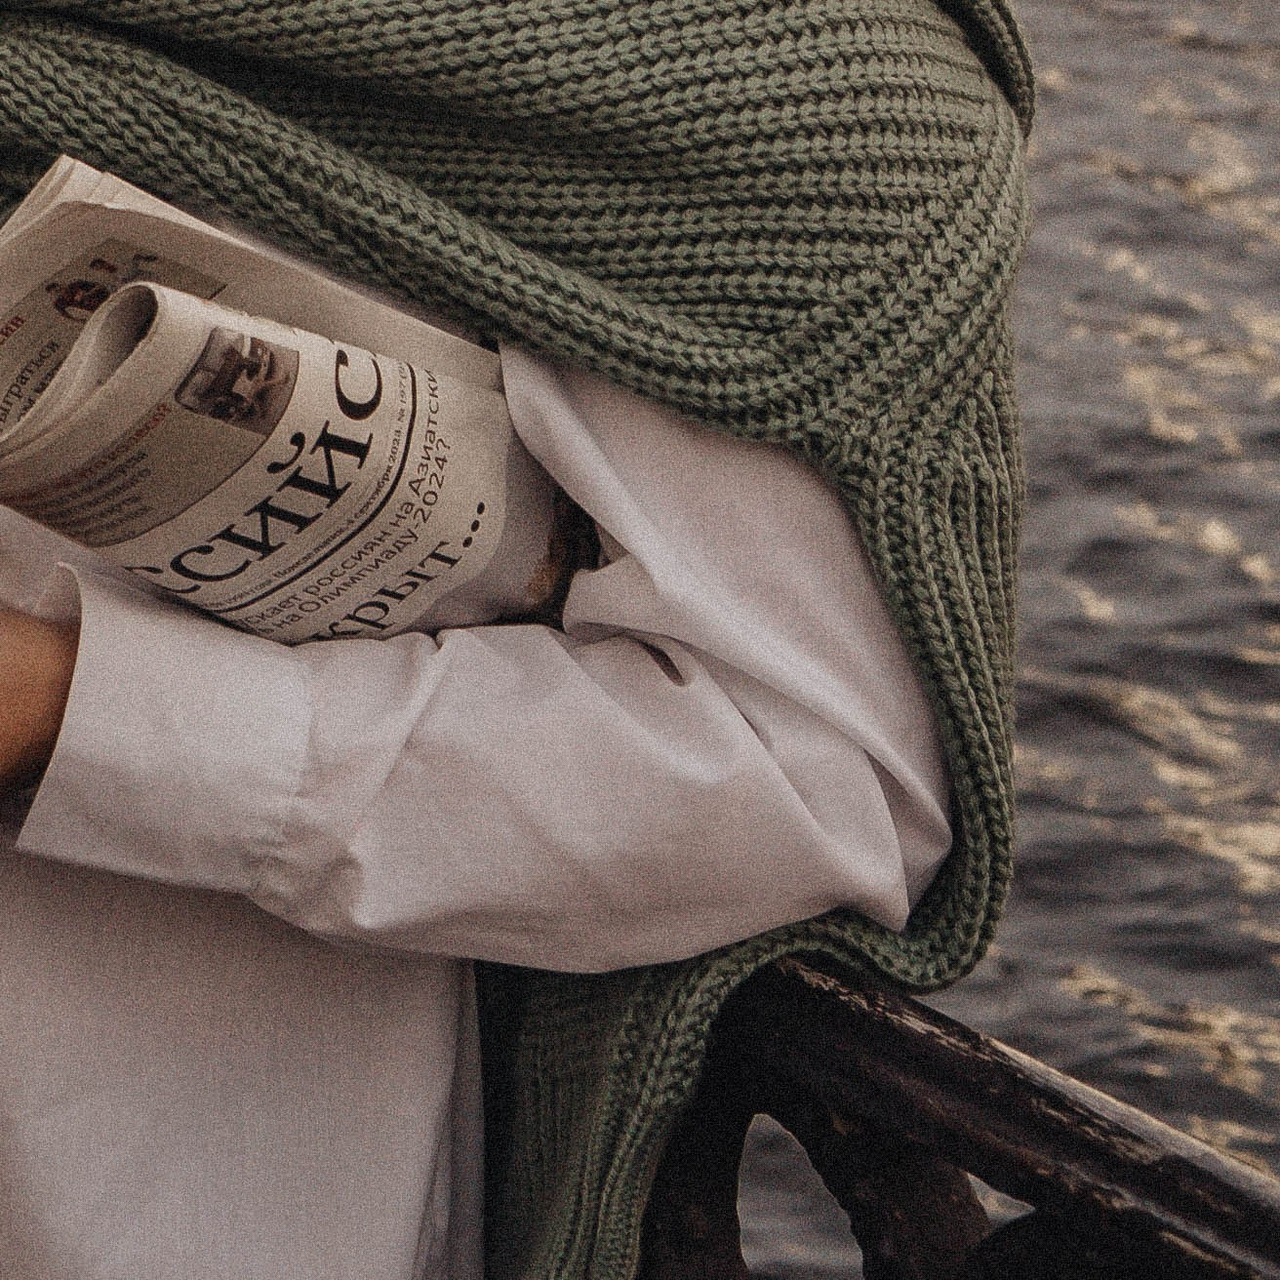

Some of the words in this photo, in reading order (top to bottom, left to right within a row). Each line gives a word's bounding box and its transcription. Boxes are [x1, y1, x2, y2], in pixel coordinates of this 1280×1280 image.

[270, 612, 303, 630] на
[298, 437, 451, 613] Олимпиаду-2024?
[305, 530, 393, 596] россиян
[388, 500, 416, 528] на
